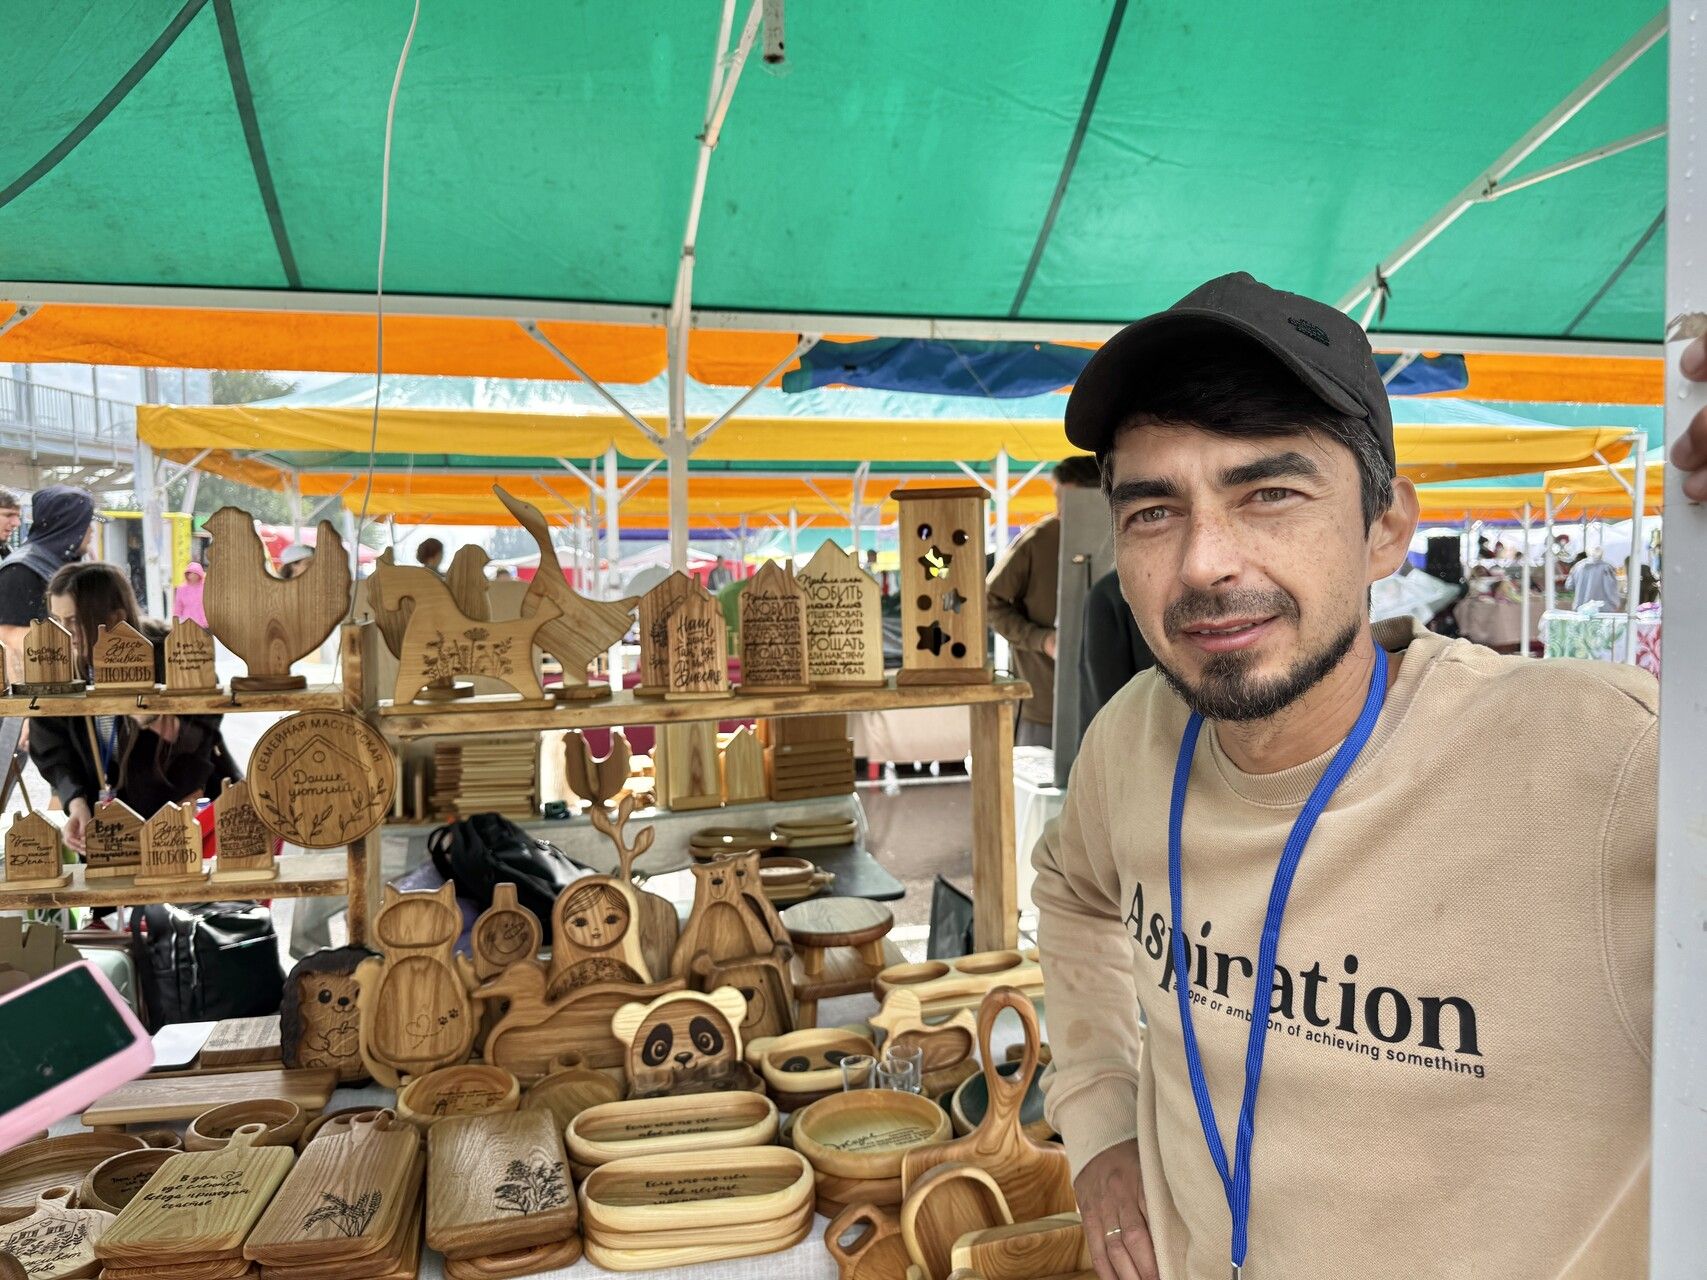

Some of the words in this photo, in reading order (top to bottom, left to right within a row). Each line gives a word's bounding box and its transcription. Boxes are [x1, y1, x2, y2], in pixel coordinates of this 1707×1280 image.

[99, 665, 151, 682] ЛЮБОВЬ
[257, 721, 307, 773] СЕМЕЙНАЯ
[311, 719, 384, 763] МАСТЕРСКАЯ
[293, 769, 344, 785] Домик
[289, 782, 355, 803] уютный
[146, 848, 197, 866] ЛЮБОВЬ
[1210, 999, 1223, 1012] or
[1226, 1005, 1282, 1032] ambon
[1287, 1024, 1301, 1037] of
[1305, 1028, 1380, 1060] achieving
[1386, 1049, 1485, 1079] something
